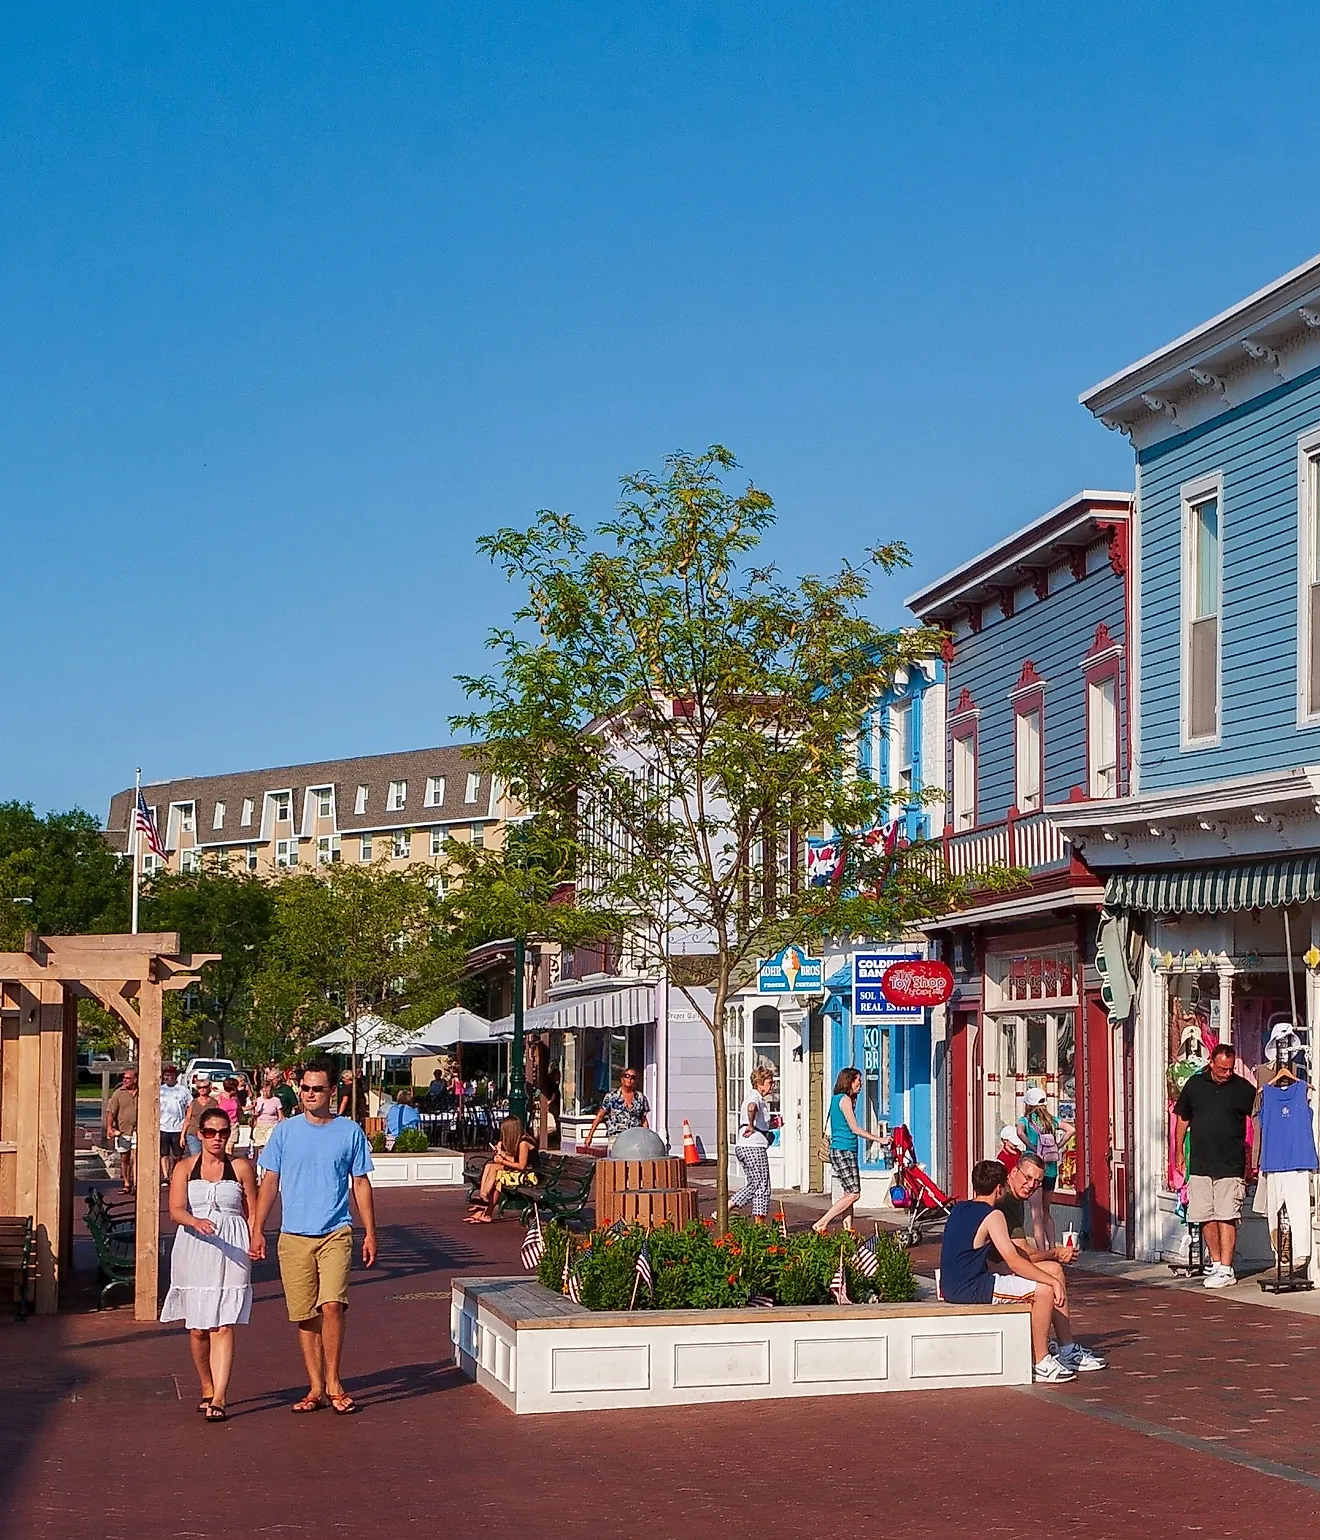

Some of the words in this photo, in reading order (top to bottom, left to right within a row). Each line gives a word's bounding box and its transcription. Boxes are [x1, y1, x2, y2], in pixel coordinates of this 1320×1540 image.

[760, 965, 782, 977] KOHR
[800, 965, 821, 977] BROS
[888, 975, 911, 993] Toy
[912, 975, 947, 991] Shop
[859, 991, 877, 1000] SOL
[860, 1003, 884, 1012] REAL
